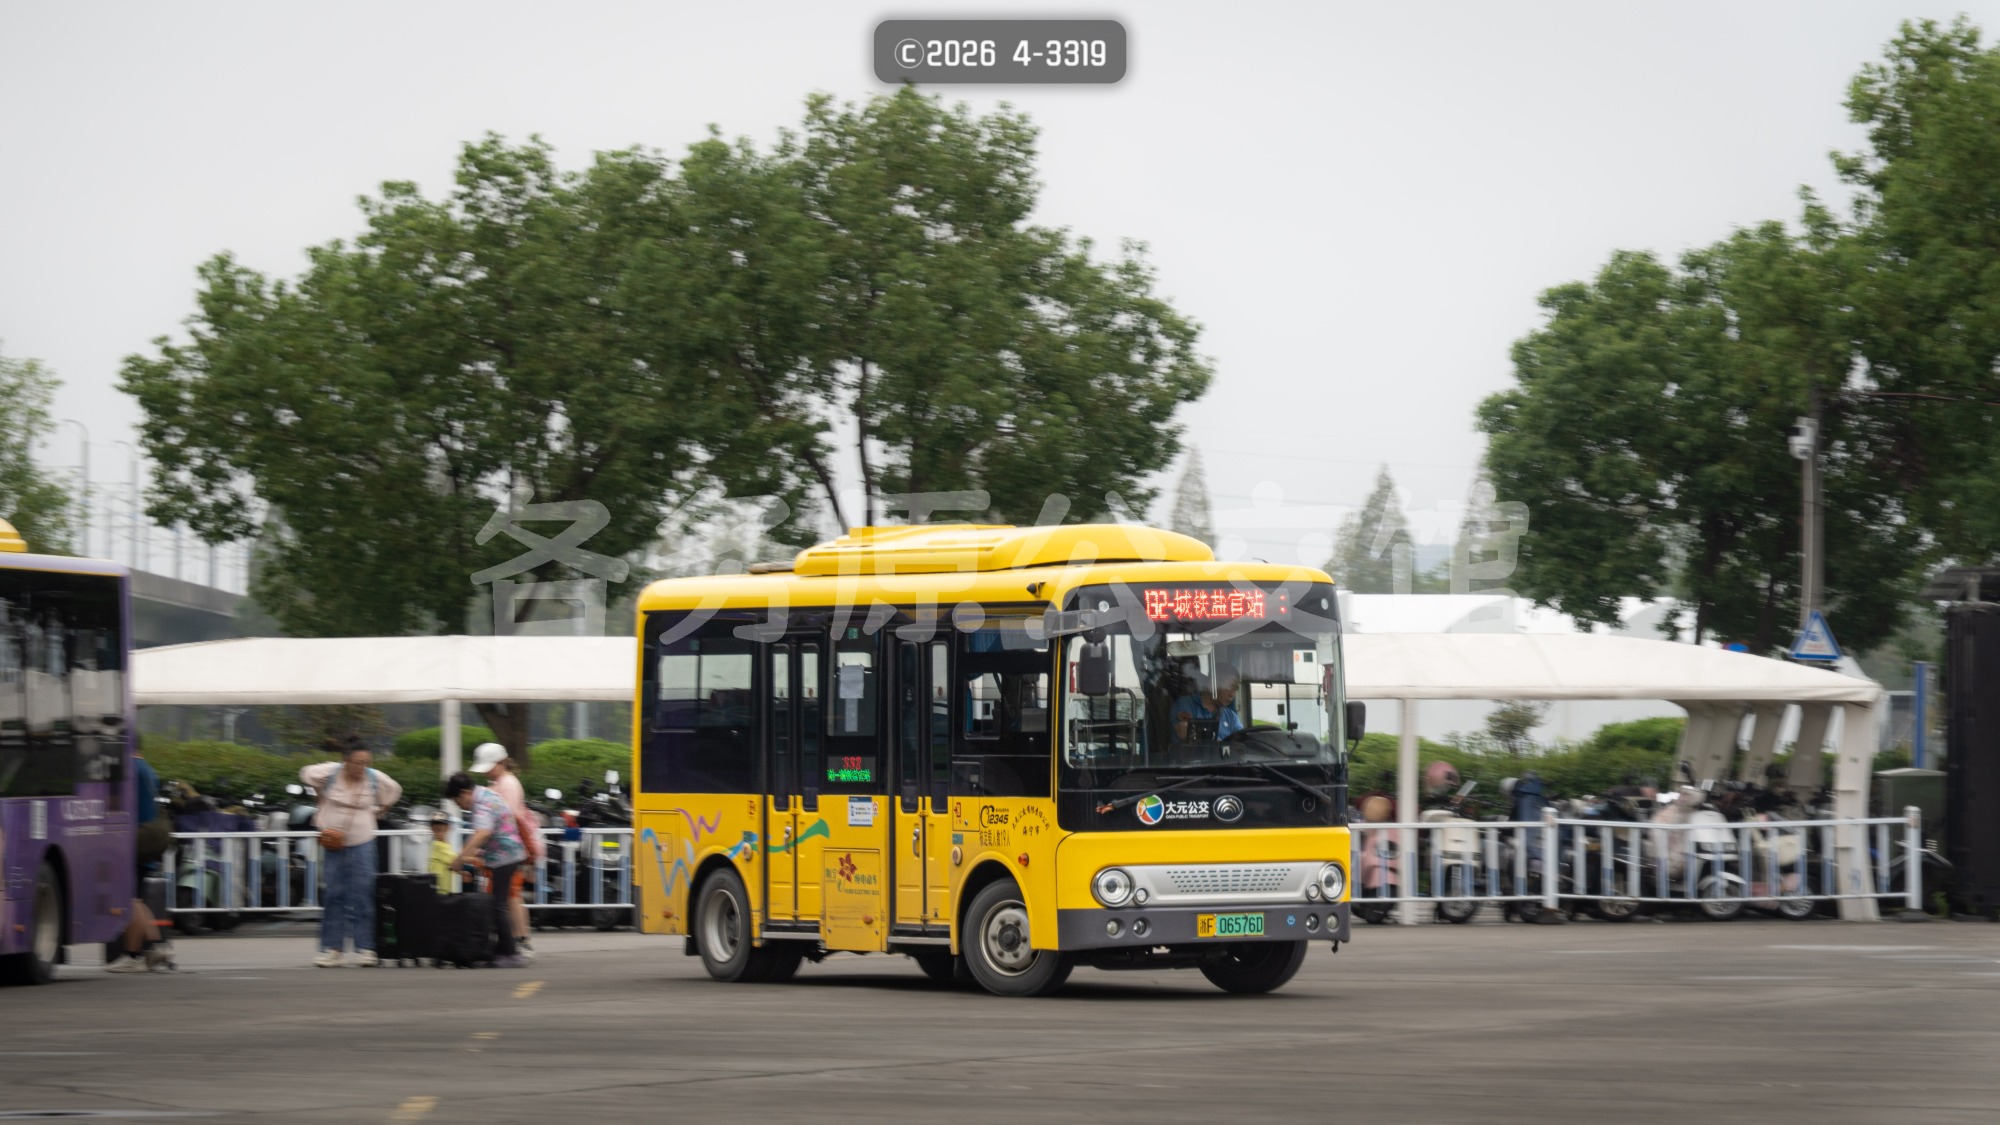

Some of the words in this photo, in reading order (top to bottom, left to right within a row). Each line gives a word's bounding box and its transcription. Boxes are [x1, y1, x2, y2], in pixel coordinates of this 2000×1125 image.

[1165, 800, 1210, 815] 大元公交
[987, 814, 1009, 824] 12345
